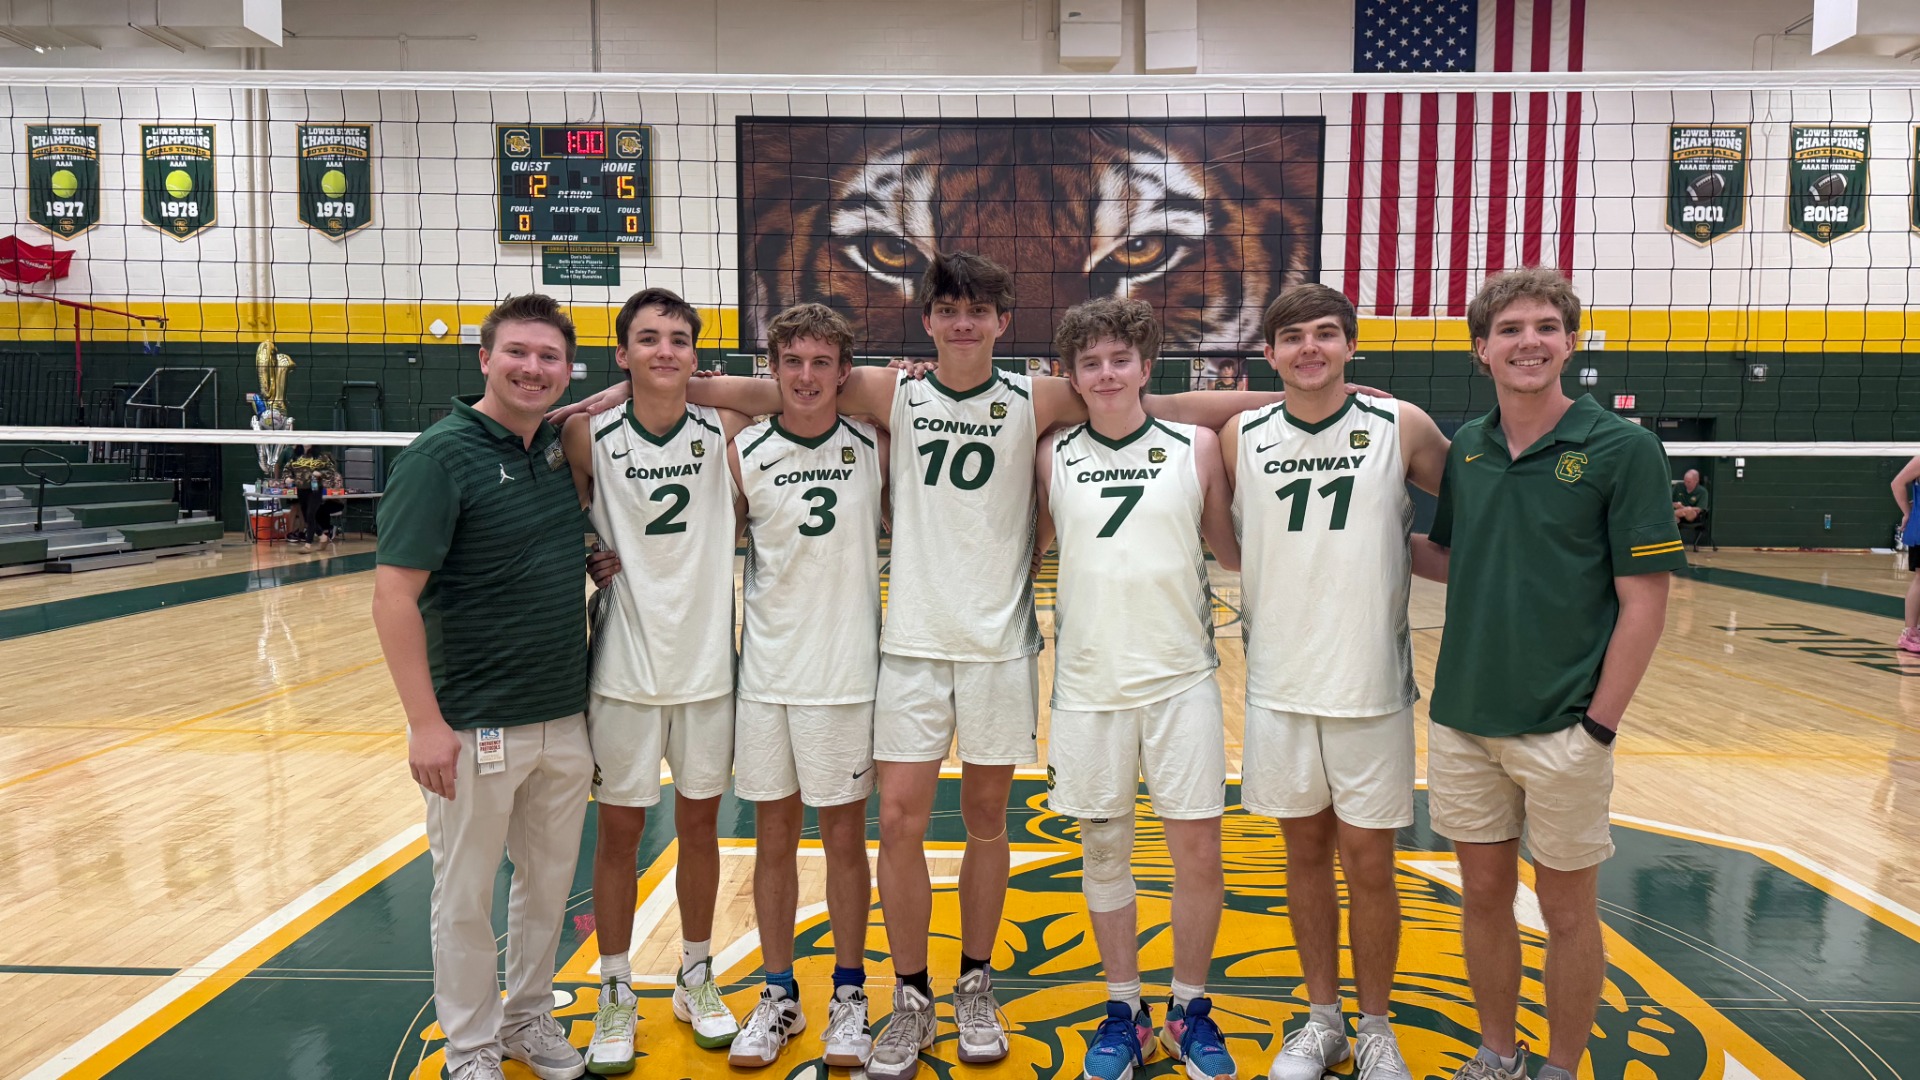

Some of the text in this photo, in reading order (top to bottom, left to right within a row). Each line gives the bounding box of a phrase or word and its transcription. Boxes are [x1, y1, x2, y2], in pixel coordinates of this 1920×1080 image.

[32, 136, 96, 148] CHAMPIONS
[146, 136, 210, 149] CHAMPIONS
[302, 136, 366, 149] CHAMPIONS
[568, 130, 604, 154] 1:00
[1674, 138, 1742, 151] CHAMPIONS
[1796, 138, 1864, 151] CHAMPIONS
[36, 147, 92, 156] GIRLS TENNIS
[150, 147, 206, 156] GIRLS TENNIS
[307, 147, 363, 156] BOYS TENNIS
[1677, 150, 1736, 158] FOOTBALL
[1800, 149, 1860, 158] FOOTBALL
[511, 161, 551, 172] GUEST
[600, 162, 636, 172] HOME
[529, 174, 548, 198] 12
[616, 176, 636, 199] 15
[557, 190, 593, 199] PERIOD
[47, 202, 84, 216] 1977
[161, 202, 198, 217] 1978
[317, 202, 354, 217] 1979
[1683, 206, 1724, 222] 2001
[1804, 206, 1848, 222] 2002
[519, 214, 530, 232] 0
[627, 216, 638, 233] 0
[914, 417, 1002, 436] CONWAY
[626, 463, 702, 479] CONWAY
[918, 439, 995, 490] 10
[1264, 455, 1366, 474] CONWAY
[774, 469, 853, 486] CONWAY
[1077, 468, 1162, 483] CONWAY
[645, 484, 690, 535] 2
[1275, 476, 1355, 531] 11
[798, 487, 837, 536] 3
[1096, 486, 1144, 538] 7
